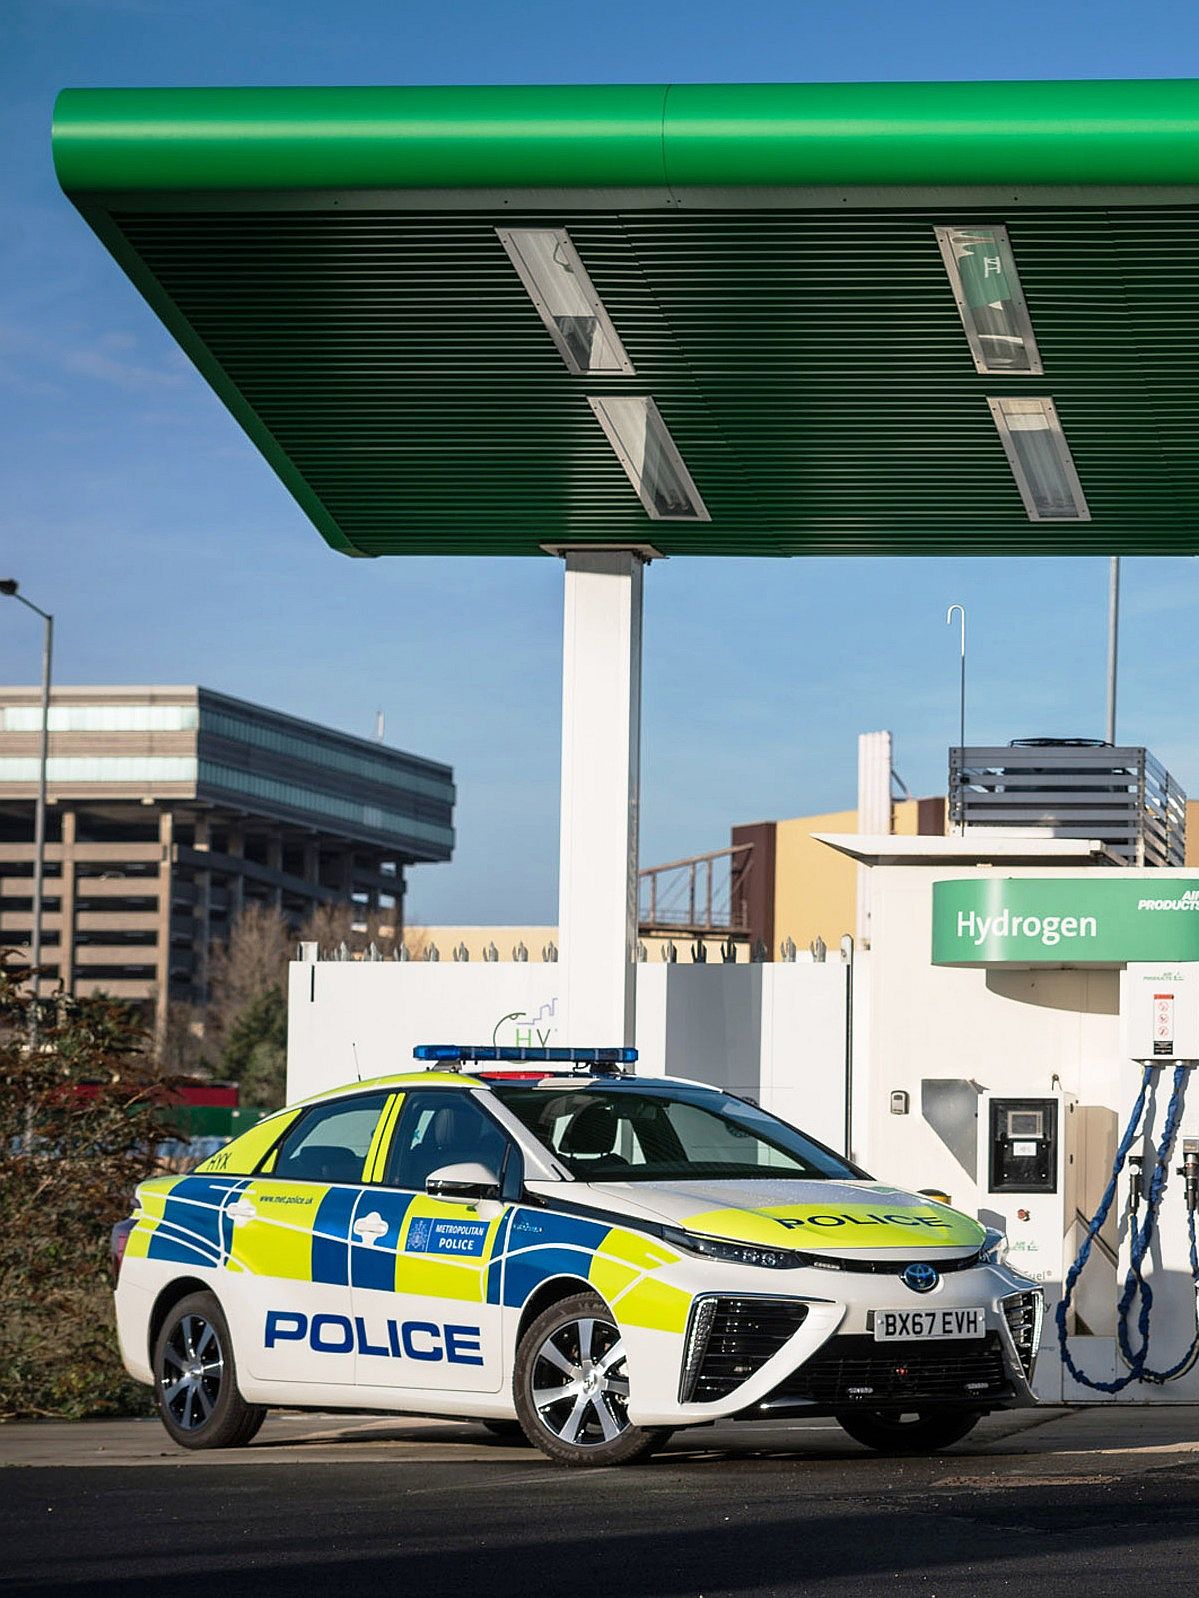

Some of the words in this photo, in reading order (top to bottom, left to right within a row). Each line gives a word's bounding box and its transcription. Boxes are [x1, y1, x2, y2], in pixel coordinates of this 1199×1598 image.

[957, 908, 1098, 946] Hydrogen
[207, 1152, 232, 1171] HYX
[435, 1224, 486, 1237] METROPOLITAN
[774, 1214, 953, 1230] POLICE
[439, 1238, 475, 1251] POLICE
[885, 1312, 936, 1336] BX67
[942, 1310, 978, 1334] EVH
[264, 1310, 484, 1366] POLICE
